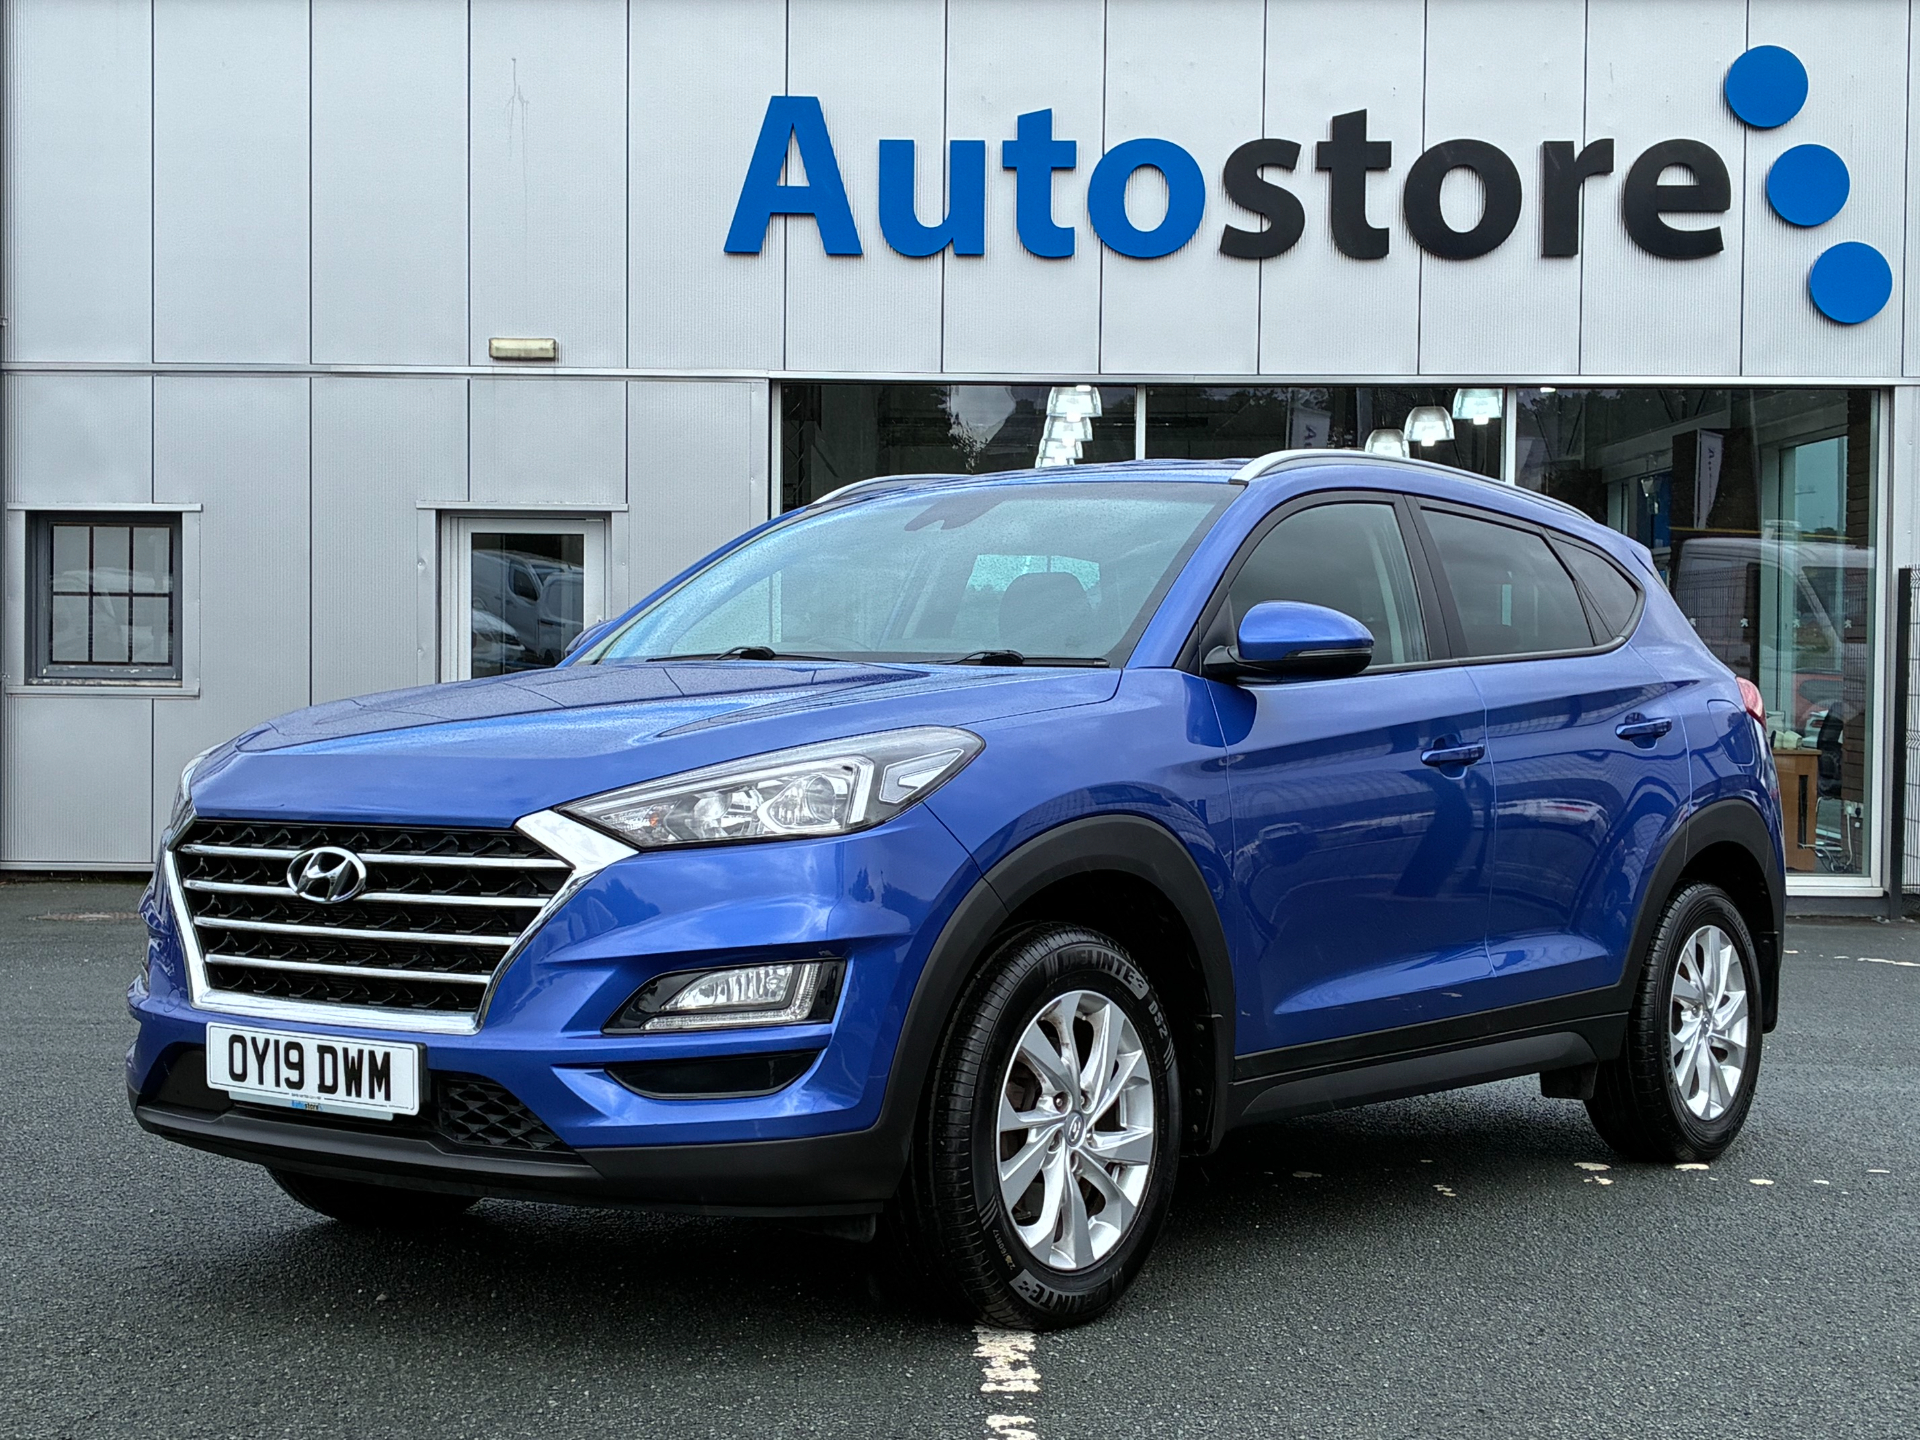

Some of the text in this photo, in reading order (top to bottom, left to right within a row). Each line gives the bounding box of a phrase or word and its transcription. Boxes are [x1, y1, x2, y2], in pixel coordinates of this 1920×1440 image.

[724, 96, 1732, 260] Autostore
[1148, 1000, 1169, 1040] DS2
[228, 1034, 392, 1101] OY19 DWM
[992, 1229, 1016, 1271] 22/60R17
[1028, 1282, 1108, 1314] LINTE
